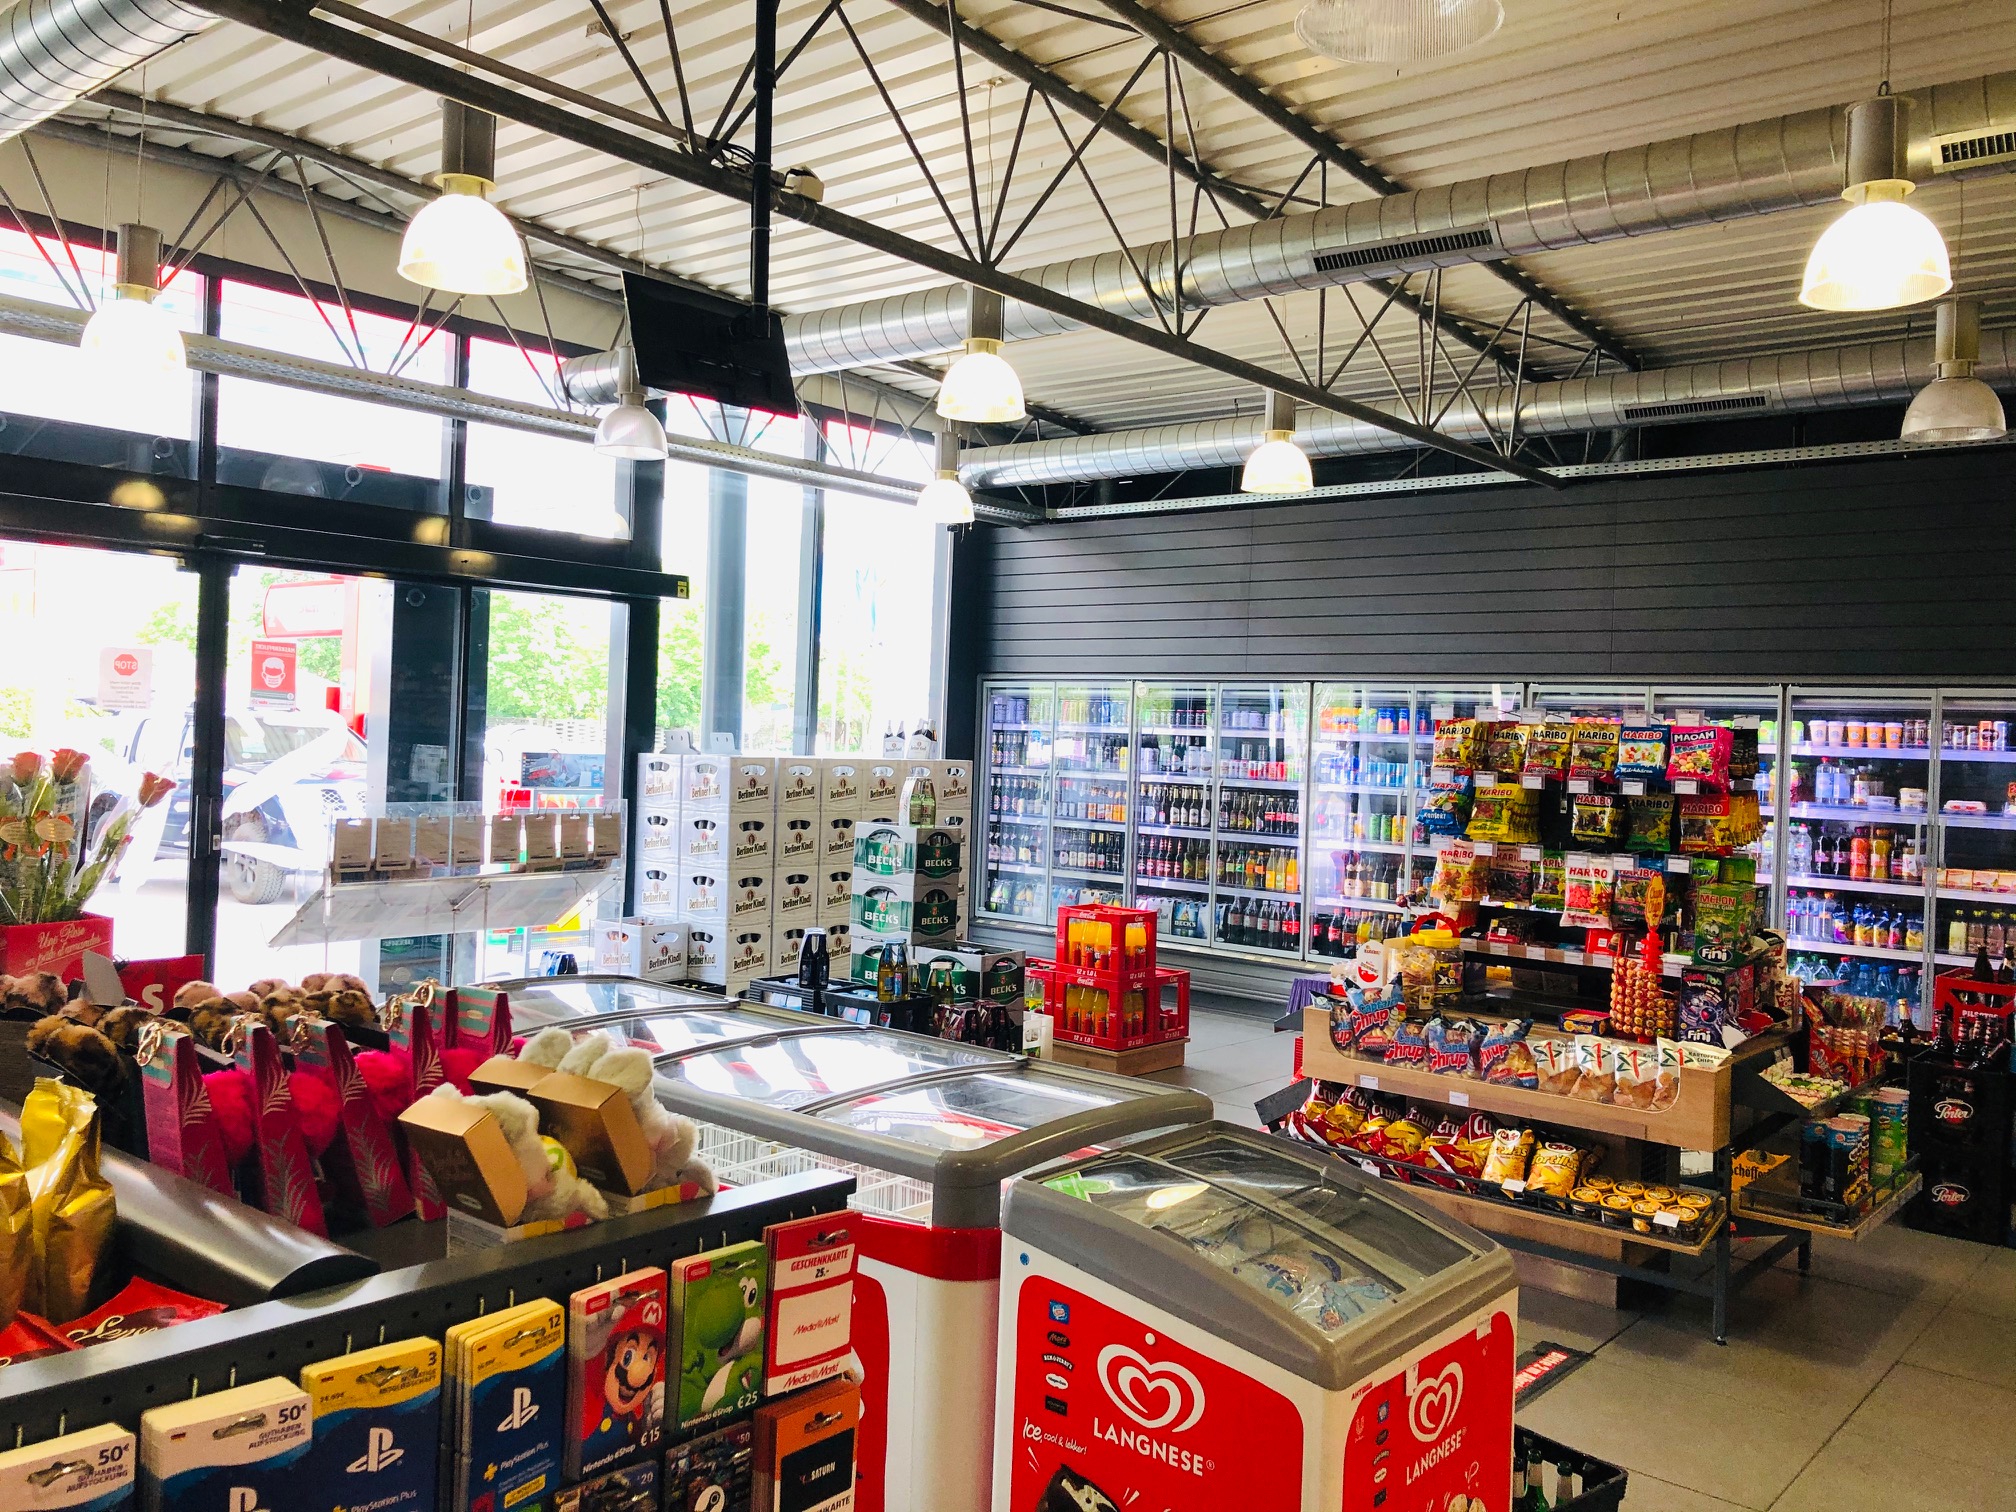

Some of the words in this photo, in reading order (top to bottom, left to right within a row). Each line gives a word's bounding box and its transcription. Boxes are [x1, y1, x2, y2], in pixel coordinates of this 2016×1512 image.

[1494, 731, 1525, 741] HARIBO
[1533, 730, 1567, 740] HARIBO
[1578, 731, 1614, 740] HARIBO
[1622, 730, 1662, 739] HARIBO
[1674, 731, 1715, 742] MAOAM
[738, 788, 755, 800] Berliner
[756, 786, 768, 797] Kindl
[786, 789, 802, 799] Berliner
[802, 786, 815, 797] Kindl
[830, 790, 845, 799] Berliner
[845, 787, 856, 797] Kindl
[870, 790, 884, 799] Berliner
[885, 786, 896, 796] Kindl
[944, 789, 957, 798] Berliner
[957, 786, 967, 796] Kindl
[1576, 794, 1612, 806] HARIBO
[1632, 799, 1669, 808] HARIBO
[1683, 804, 1723, 814] HARIBO
[644, 838, 660, 848] Berliner
[690, 842, 707, 853] Berliner
[707, 841, 718, 851] Kindl
[736, 845, 754, 856] Berliner
[754, 842, 767, 853] Kindl
[785, 844, 801, 854] Berliner
[802, 841, 814, 851] Kindl
[828, 842, 845, 852] Berliner
[845, 840, 854, 849] Kind
[868, 854, 902, 867] BECK'S
[1441, 850, 1473, 858] HARIBO
[1497, 853, 1528, 863] HARI
[925, 858, 952, 867] BECK'S
[1569, 867, 1608, 878] HARIBO
[643, 892, 658, 902] Berliner
[658, 890, 671, 902] Kindl
[782, 899, 799, 909] Berliner
[799, 893, 811, 905] Kindl
[827, 896, 843, 906] Berliner
[1700, 894, 1736, 906] MELON
[689, 898, 705, 910] Berliner
[706, 896, 718, 908] Kindl
[736, 901, 753, 912] Berliner
[753, 898, 766, 911] Kindl
[864, 910, 898, 924] BECK'S
[921, 916, 948, 926] BECK'S
[828, 948, 842, 958] erliner
[1702, 948, 1727, 961] Fini
[649, 957, 667, 969] Berliner
[668, 952, 681, 966] Kindl
[734, 958, 751, 969] Berliner
[751, 953, 764, 966] Kindl
[990, 984, 1017, 995] BECK'S
[1351, 1008, 1389, 1035] Chrup
[1687, 1029, 1711, 1043] Fini
[1384, 1041, 1426, 1062] Chrup
[1429, 1049, 1469, 1071] Chrup
[791, 1248, 848, 1272] GESCHENKKARTE
[548, 1314, 561, 1329] 12
[428, 1351, 437, 1366] 3
[738, 1391, 757, 1408] €25
[278, 1403, 308, 1424] 50€
[681, 1414, 711, 1430] Nintendo
[712, 1405, 734, 1419] eShop
[1023, 1417, 1043, 1443] Ice,
[1044, 1432, 1058, 1444] cool
[1058, 1436, 1063, 1447] &
[1065, 1437, 1087, 1455] lekker!
[1094, 1417, 1203, 1477] LANGNESE
[98, 1443, 130, 1466] 50€
[500, 1447, 536, 1471] PlayStation
[537, 1440, 550, 1453] Plus
[583, 1454, 614, 1474] Nintendo
[615, 1444, 636, 1459] eShop
[1406, 1429, 1462, 1486] LANGNESE
[811, 1462, 836, 1481] SATURN
[351, 1495, 399, 1512] PlayStation
[400, 1490, 417, 1501] Plus
